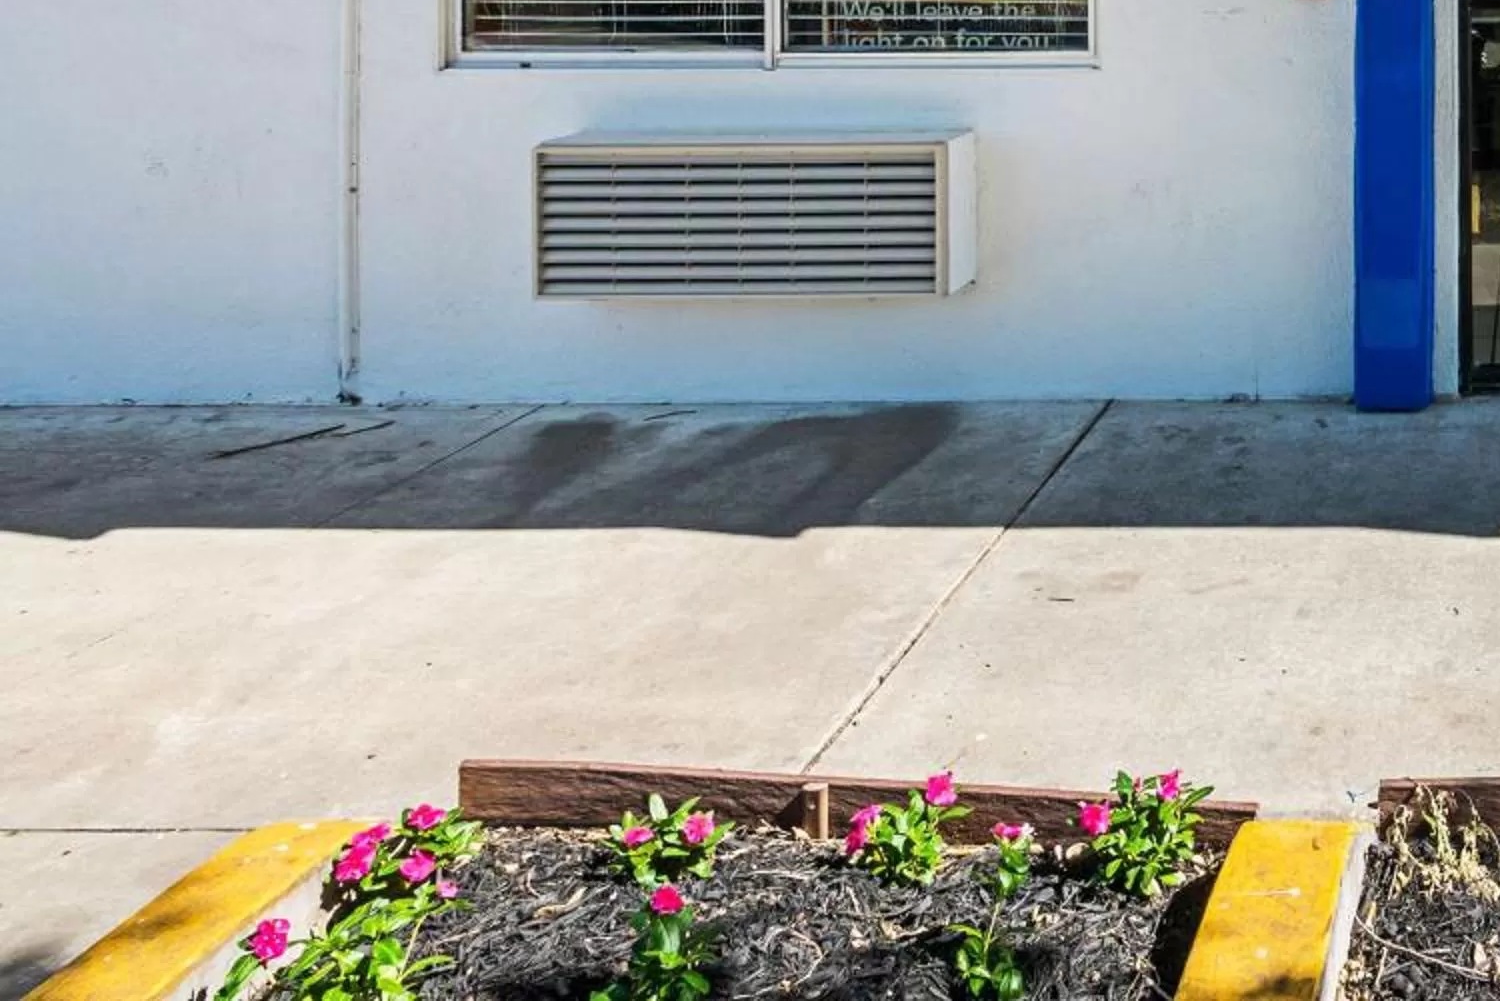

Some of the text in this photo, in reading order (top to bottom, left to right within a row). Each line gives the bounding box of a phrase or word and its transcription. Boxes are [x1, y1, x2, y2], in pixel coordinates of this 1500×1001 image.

[843, 0, 1036, 20] We'll leave the
[845, 28, 1050, 48] light on for you
